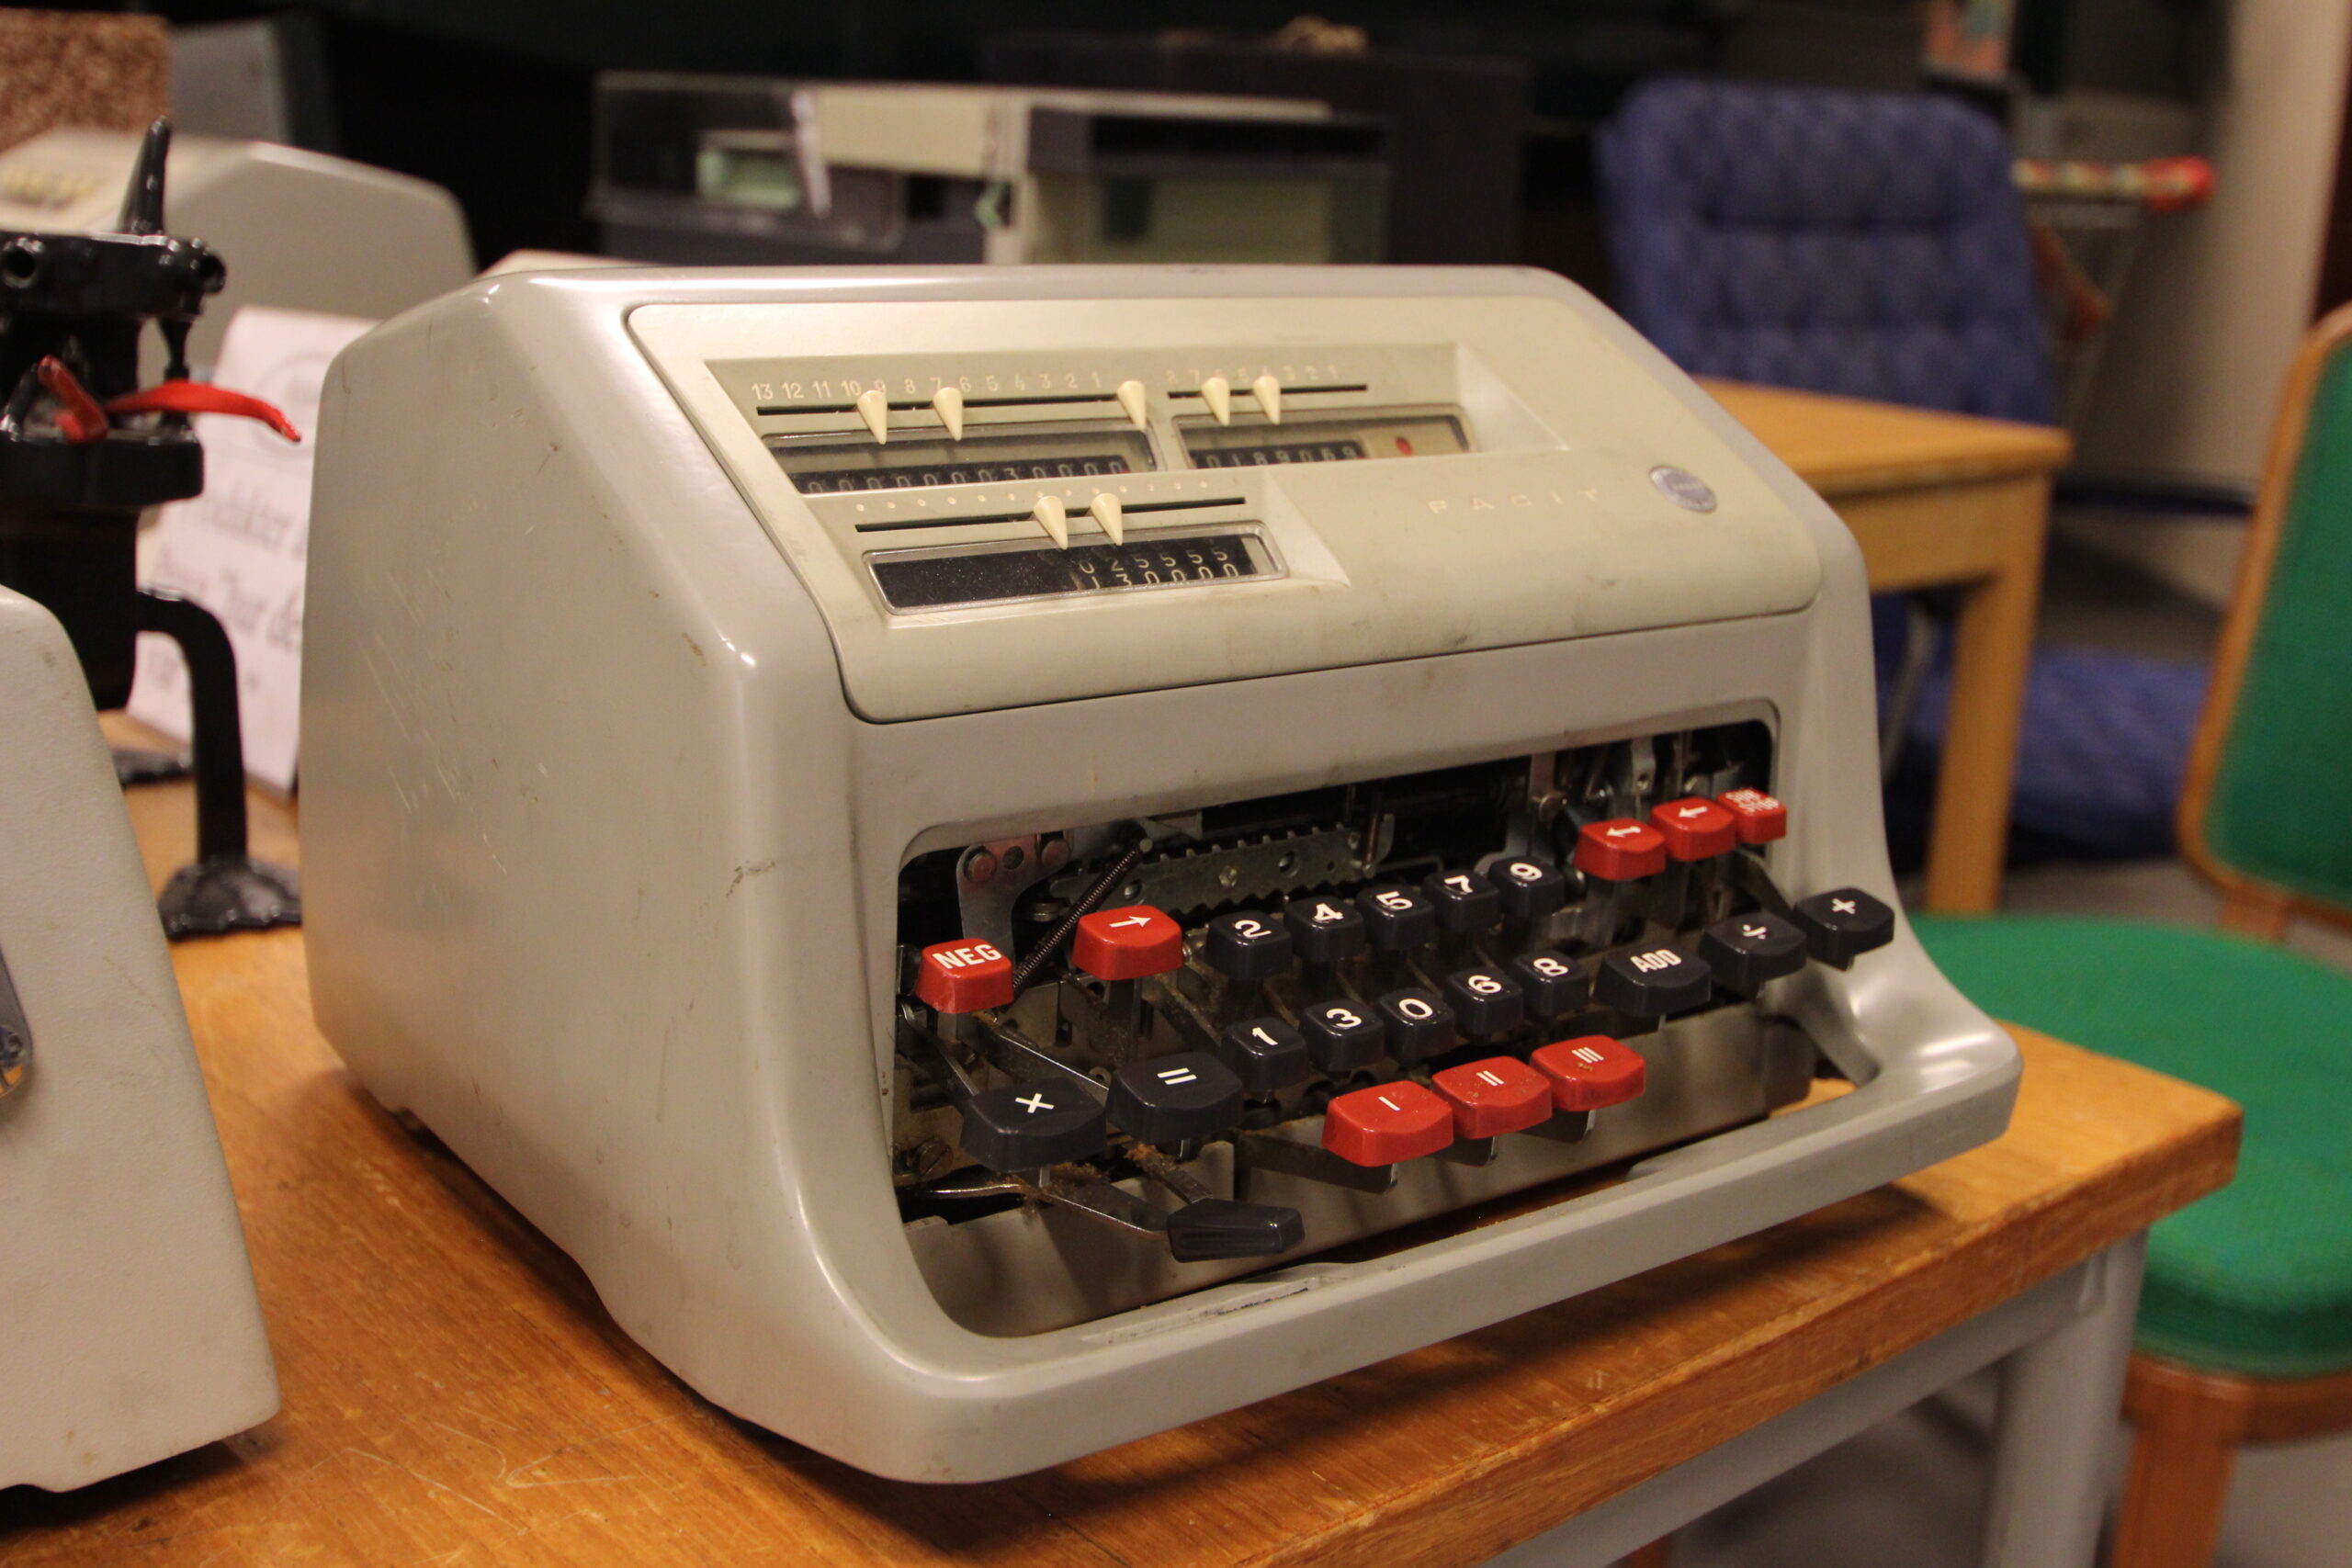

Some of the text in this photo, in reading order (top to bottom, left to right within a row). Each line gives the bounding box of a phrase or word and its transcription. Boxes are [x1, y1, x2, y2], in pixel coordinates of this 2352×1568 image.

[752, 383, 773, 400] 13
[782, 382, 804, 399] 12
[812, 380, 831, 398] 11
[842, 379, 861, 397] 10
[875, 379, 887, 394] 9
[904, 378, 916, 394] 8
[959, 376, 971, 392] 6
[986, 375, 999, 391] 5
[1014, 374, 1025, 390] 4
[1039, 374, 1051, 389] 3
[1065, 373, 1078, 389] 2
[1091, 371, 1101, 388] 1
[1234, 862, 1544, 940] 2 4 5 7 9
[932, 943, 1002, 970] NEG
[1630, 949, 1682, 973] ADD
[1251, 957, 1568, 1046] 1 3 0 6 8
